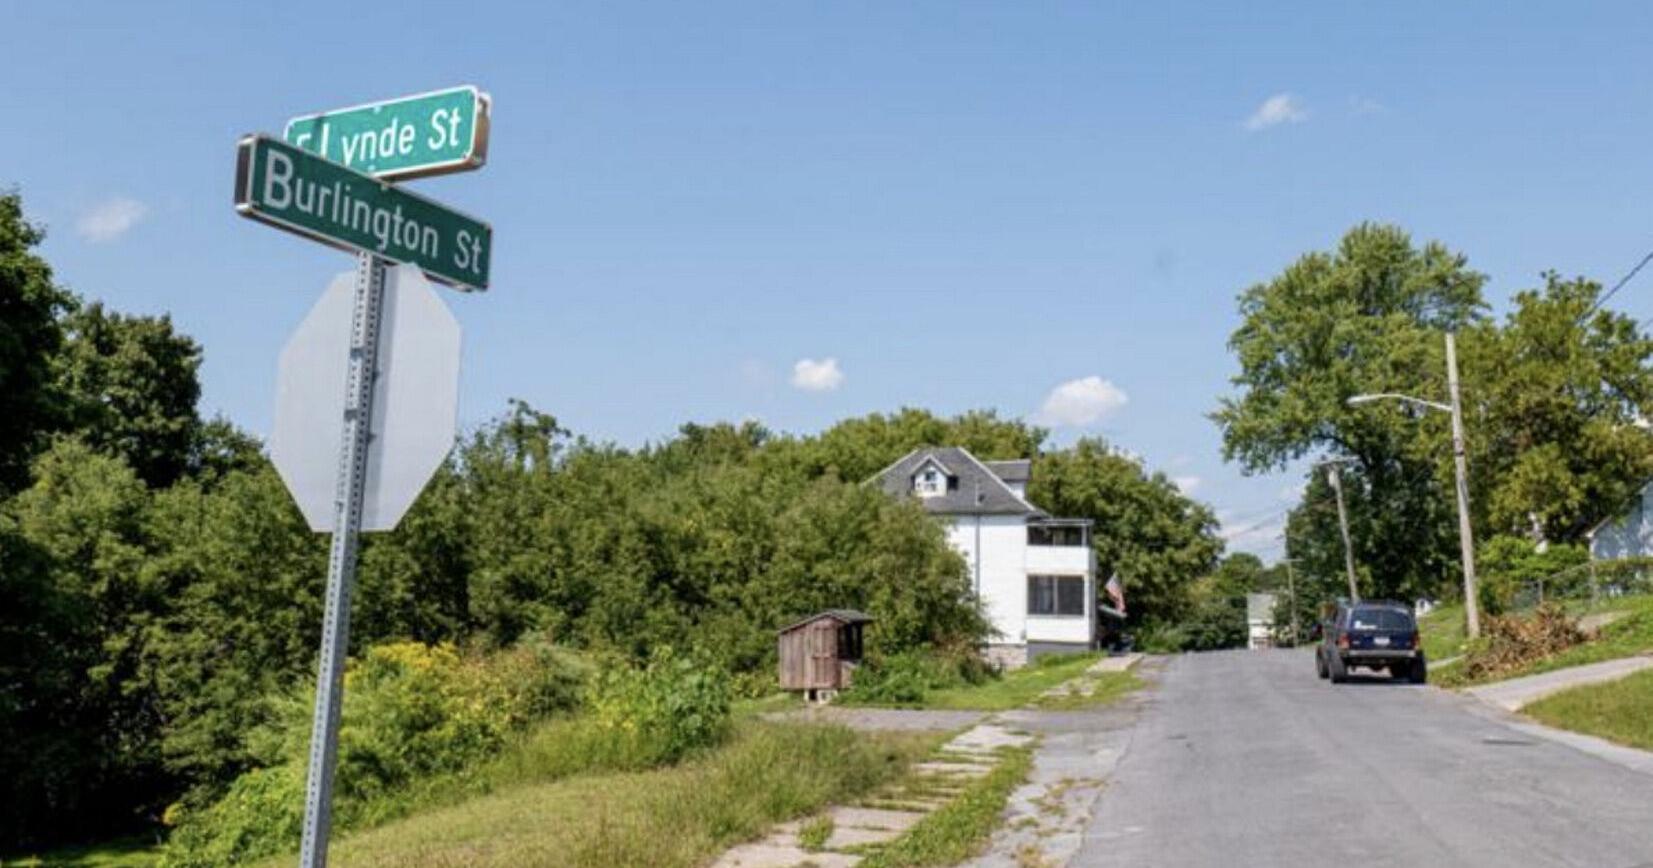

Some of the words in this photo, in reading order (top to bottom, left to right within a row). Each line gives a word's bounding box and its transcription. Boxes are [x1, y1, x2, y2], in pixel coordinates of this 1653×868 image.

[428, 107, 461, 150] St
[263, 149, 438, 258] Burlington
[454, 230, 482, 273] St
